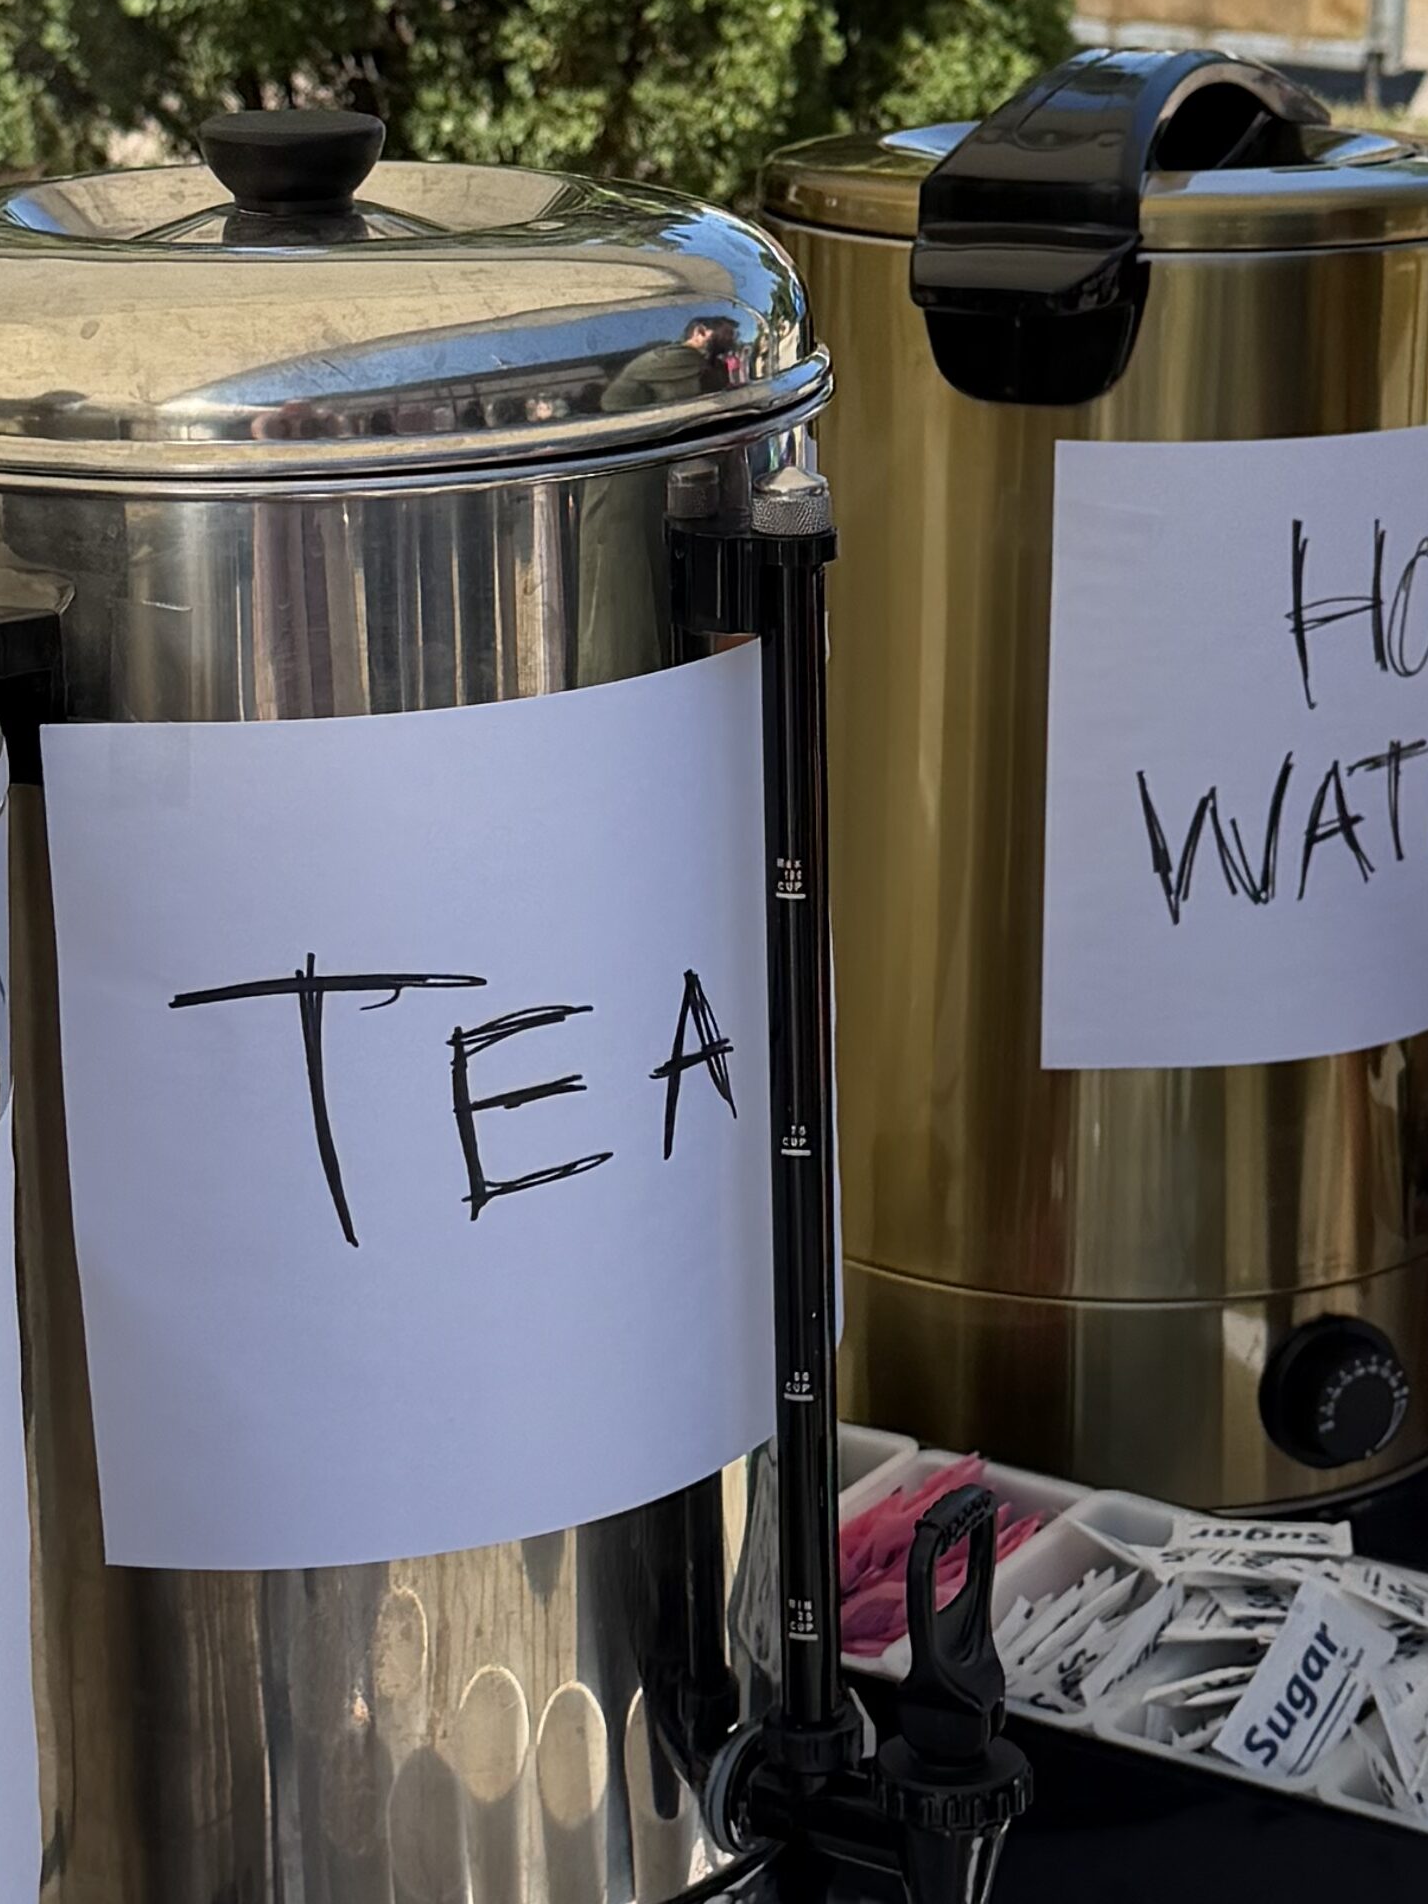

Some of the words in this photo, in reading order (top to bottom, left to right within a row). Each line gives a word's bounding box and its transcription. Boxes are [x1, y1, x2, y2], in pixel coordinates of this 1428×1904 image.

[777, 881, 803, 892] CUP
[167, 952, 740, 1247] TEA
[782, 1136, 807, 1147] CUP
[1189, 1526, 1332, 1545] Sugar
[1243, 1621, 1339, 1768] Sugar
